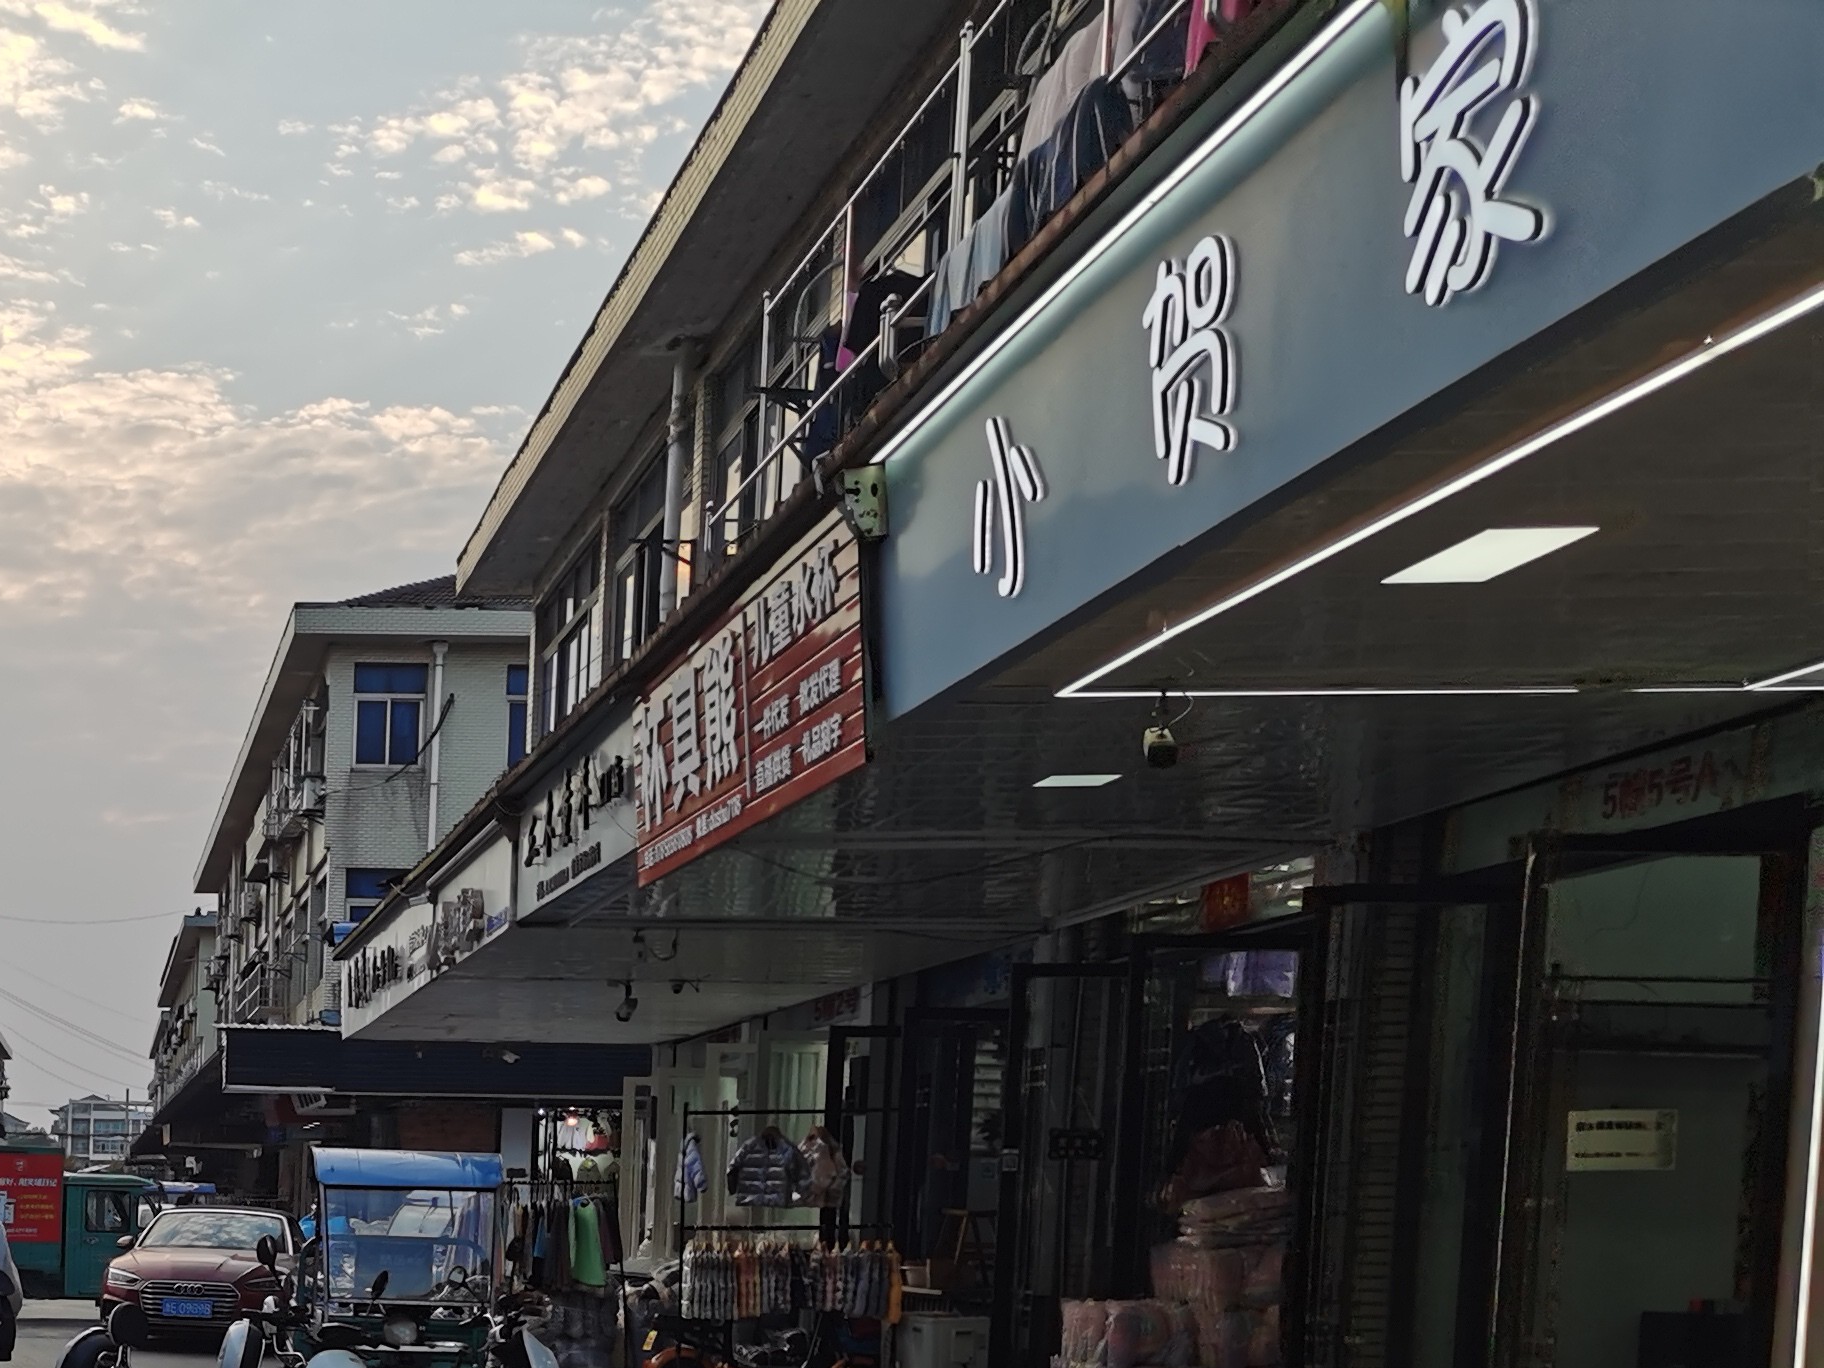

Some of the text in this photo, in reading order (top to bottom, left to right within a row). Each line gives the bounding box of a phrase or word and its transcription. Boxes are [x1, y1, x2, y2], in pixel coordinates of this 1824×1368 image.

[971, 0, 1552, 599] 小贺家
[751, 539, 841, 669] 儿童水杯
[638, 633, 740, 833] 杯具熊
